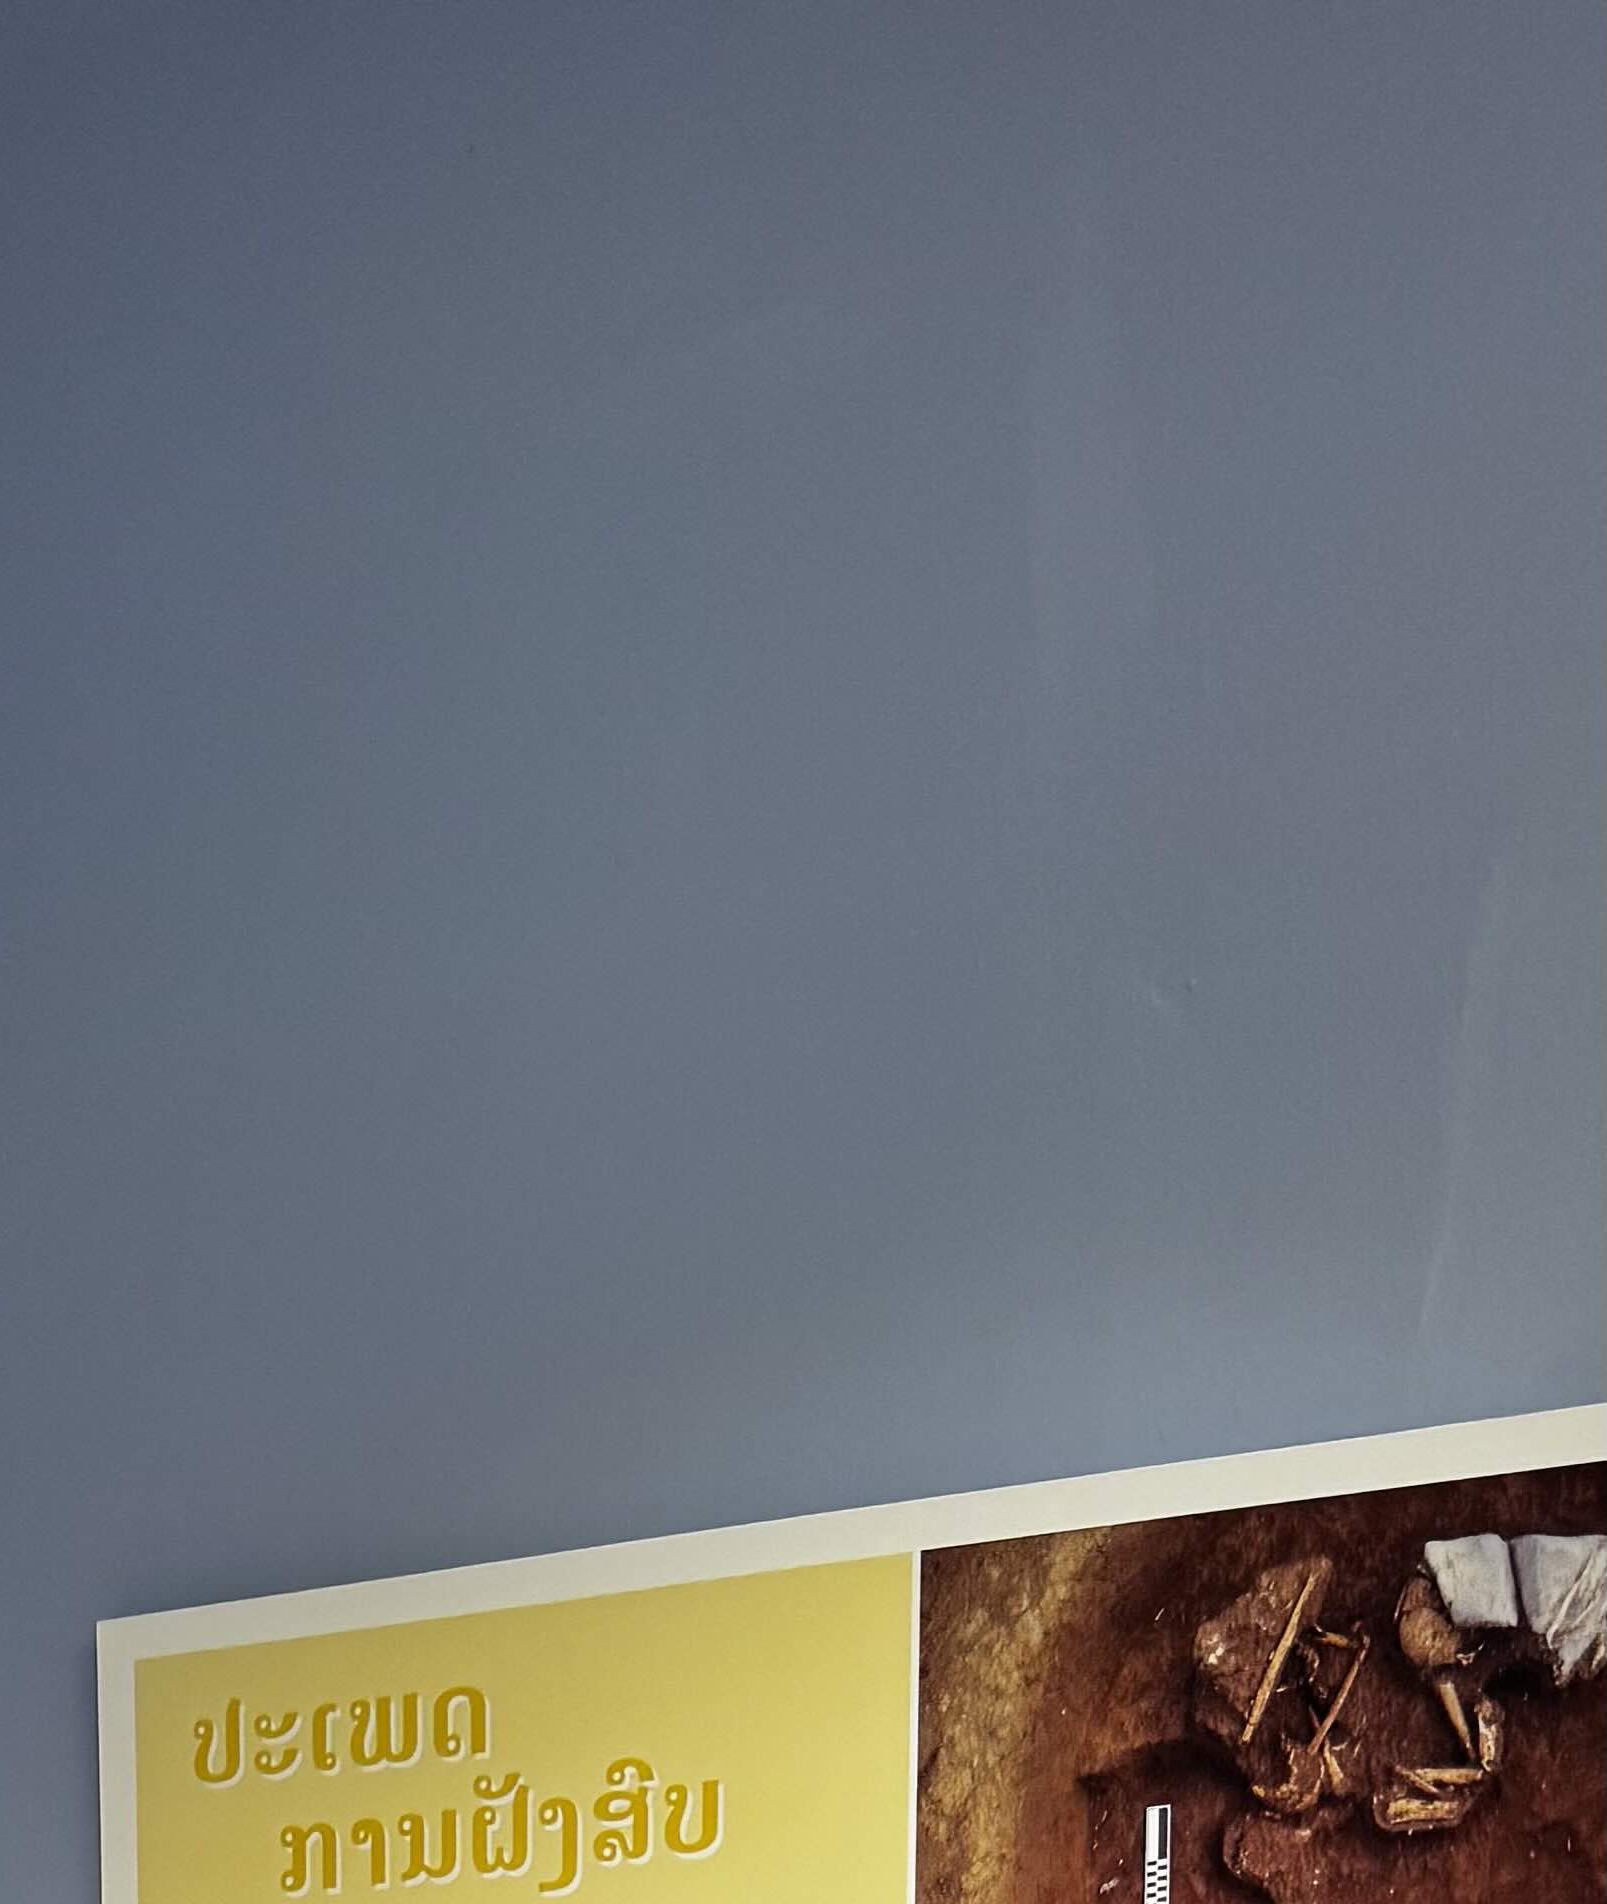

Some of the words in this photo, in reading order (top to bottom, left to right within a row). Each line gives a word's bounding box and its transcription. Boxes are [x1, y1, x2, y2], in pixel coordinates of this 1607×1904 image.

[194, 1684, 493, 1787] ປະເພດ
[280, 1755, 725, 1899] ການຝັງສົບ
